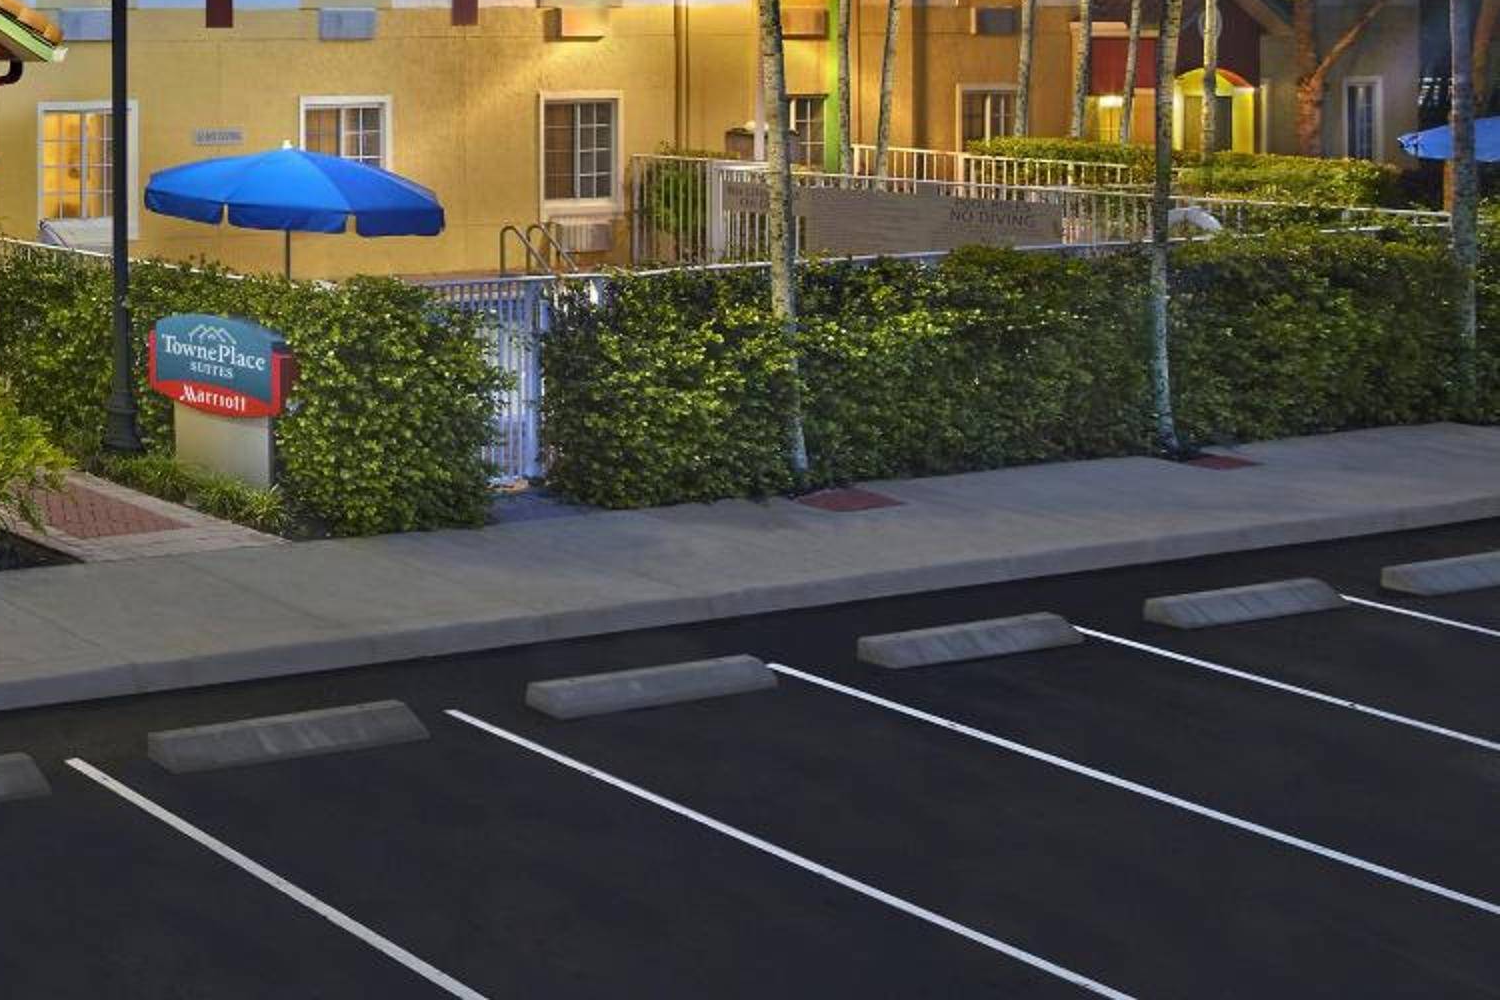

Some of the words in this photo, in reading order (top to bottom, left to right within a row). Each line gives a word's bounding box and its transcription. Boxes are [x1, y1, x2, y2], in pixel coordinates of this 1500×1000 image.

[950, 208, 974, 222] NO
[978, 211, 1037, 228] DIVING
[162, 334, 266, 371] TownePlace
[189, 361, 234, 378] SUITES
[179, 384, 246, 411] Marriott
